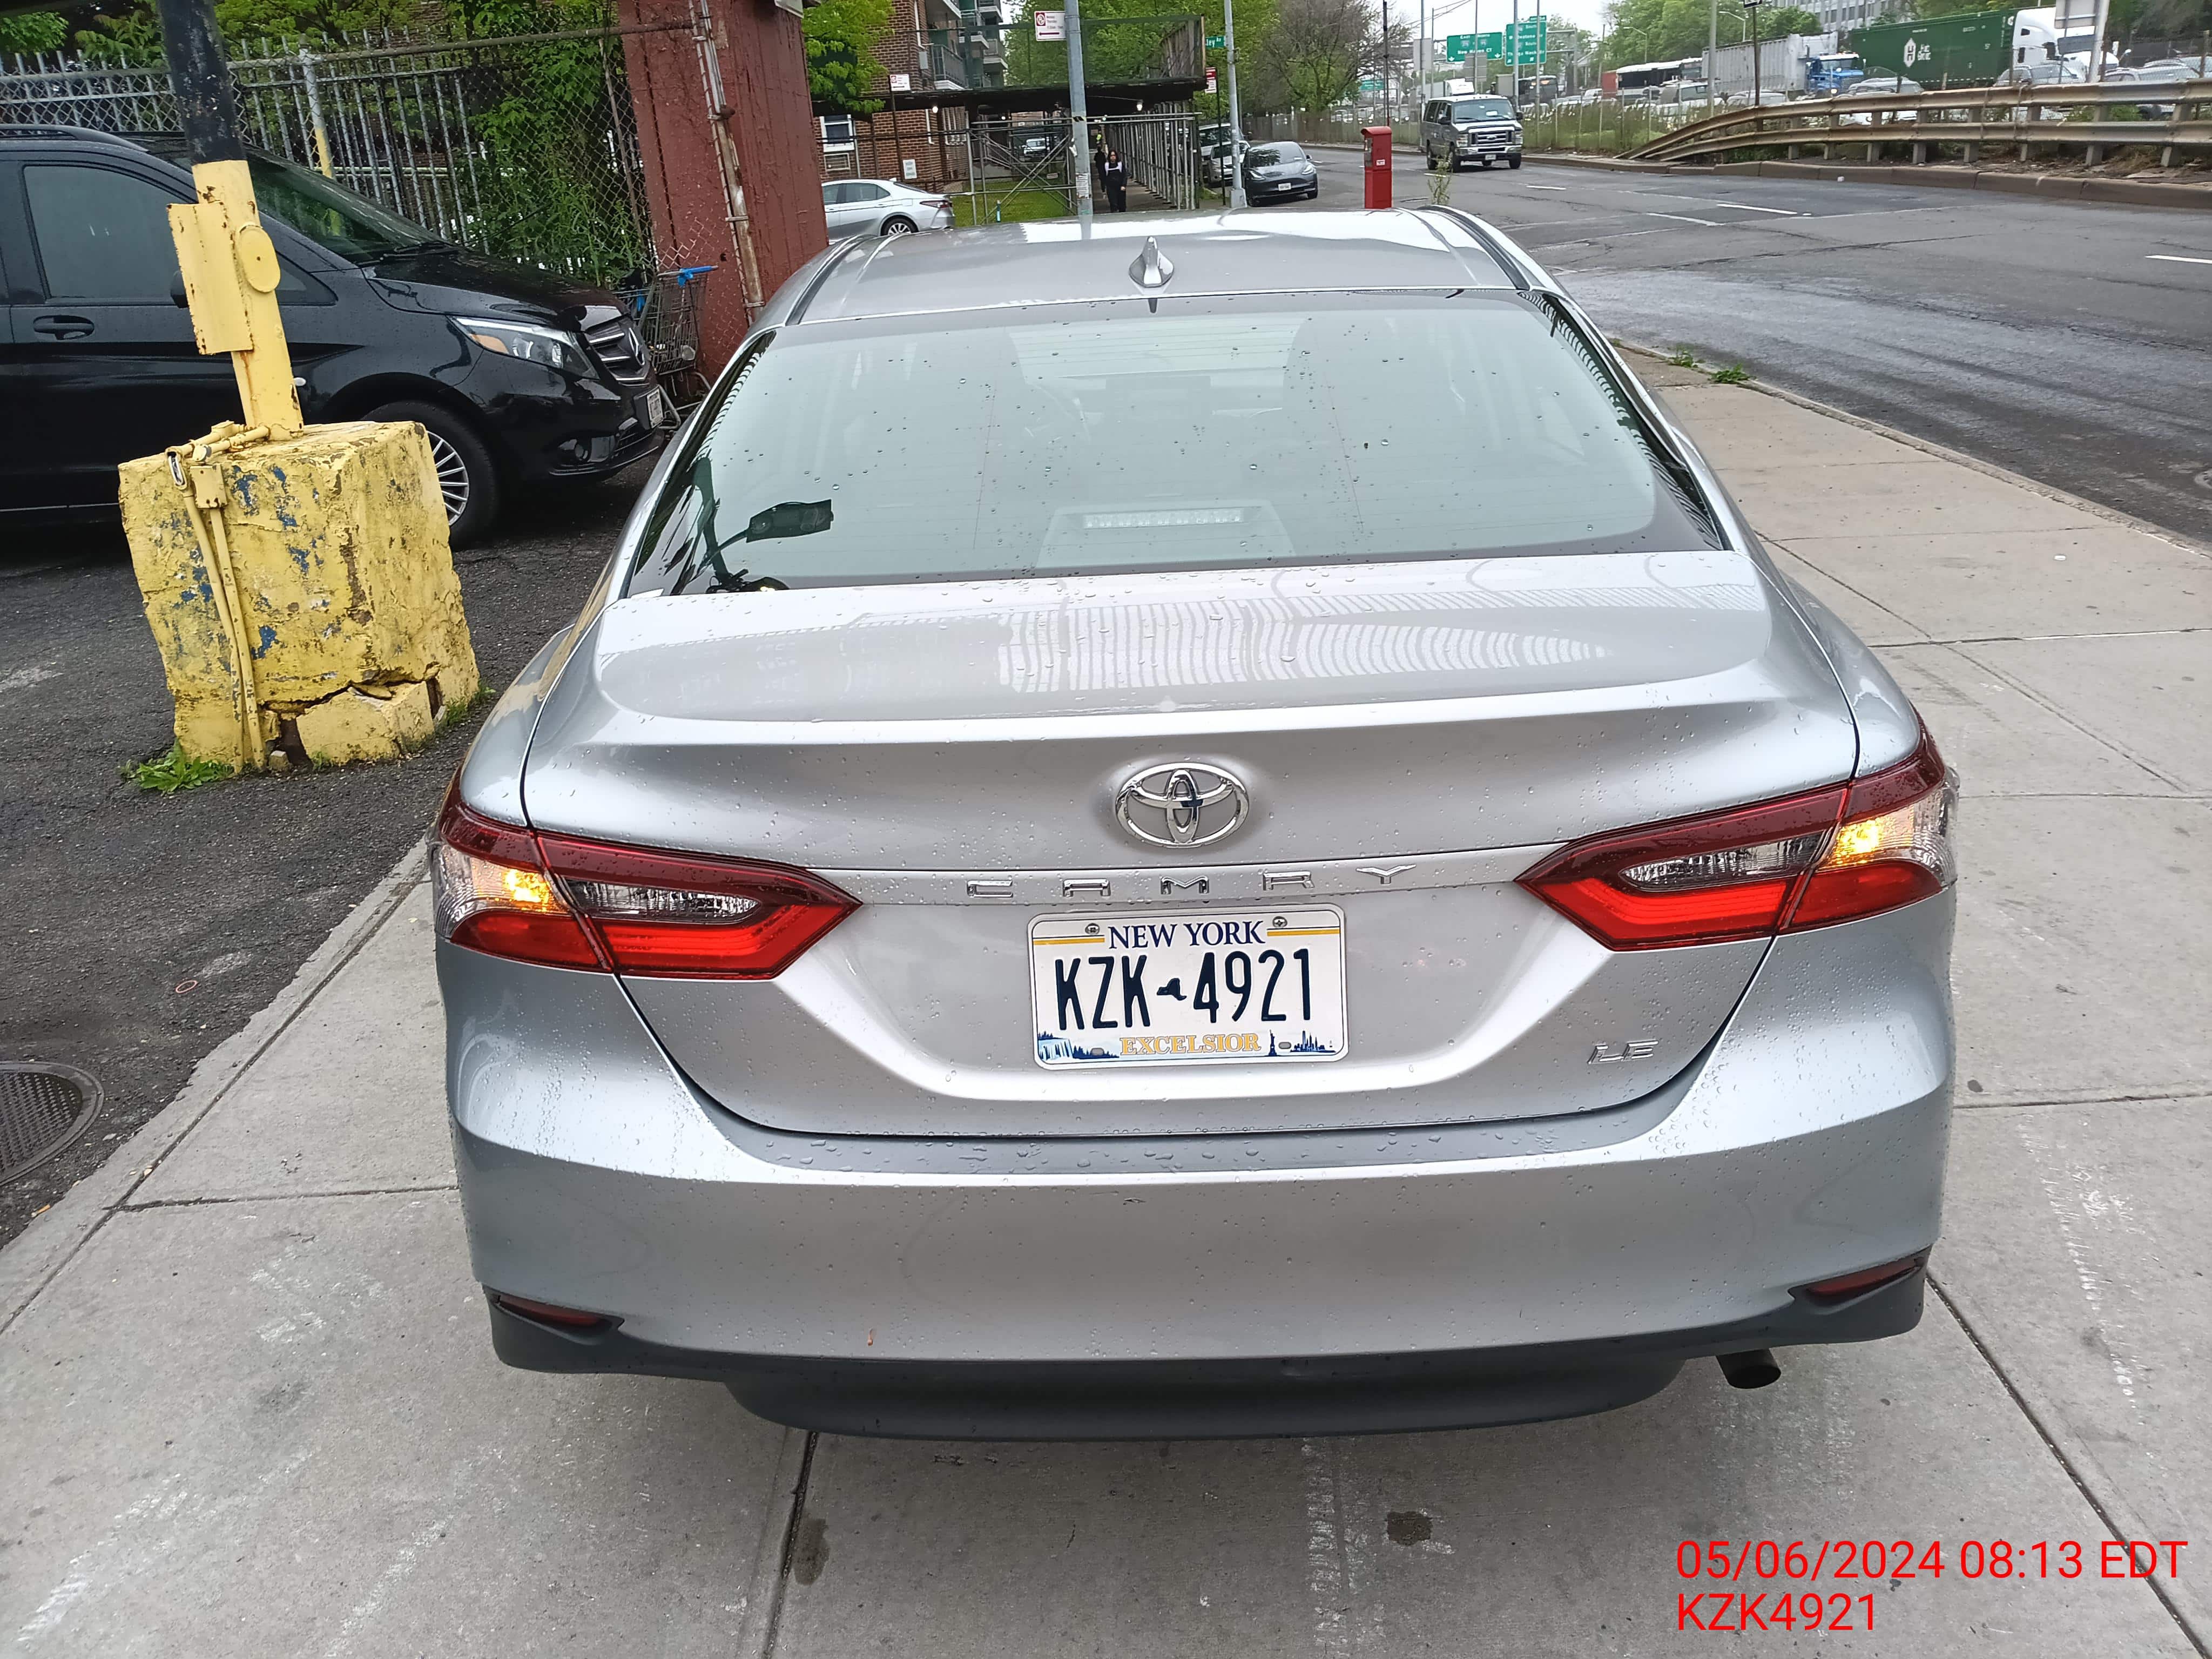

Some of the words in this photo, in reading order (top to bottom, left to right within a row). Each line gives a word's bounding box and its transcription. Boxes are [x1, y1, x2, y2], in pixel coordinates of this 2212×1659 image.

[967, 864, 1415, 897] CAMRY
[1109, 924, 1177, 949] NEW
[1184, 921, 1266, 946] YORK
[1120, 1033, 1261, 1056] EXCELSIOR
[1587, 1039, 1658, 1064] LE
